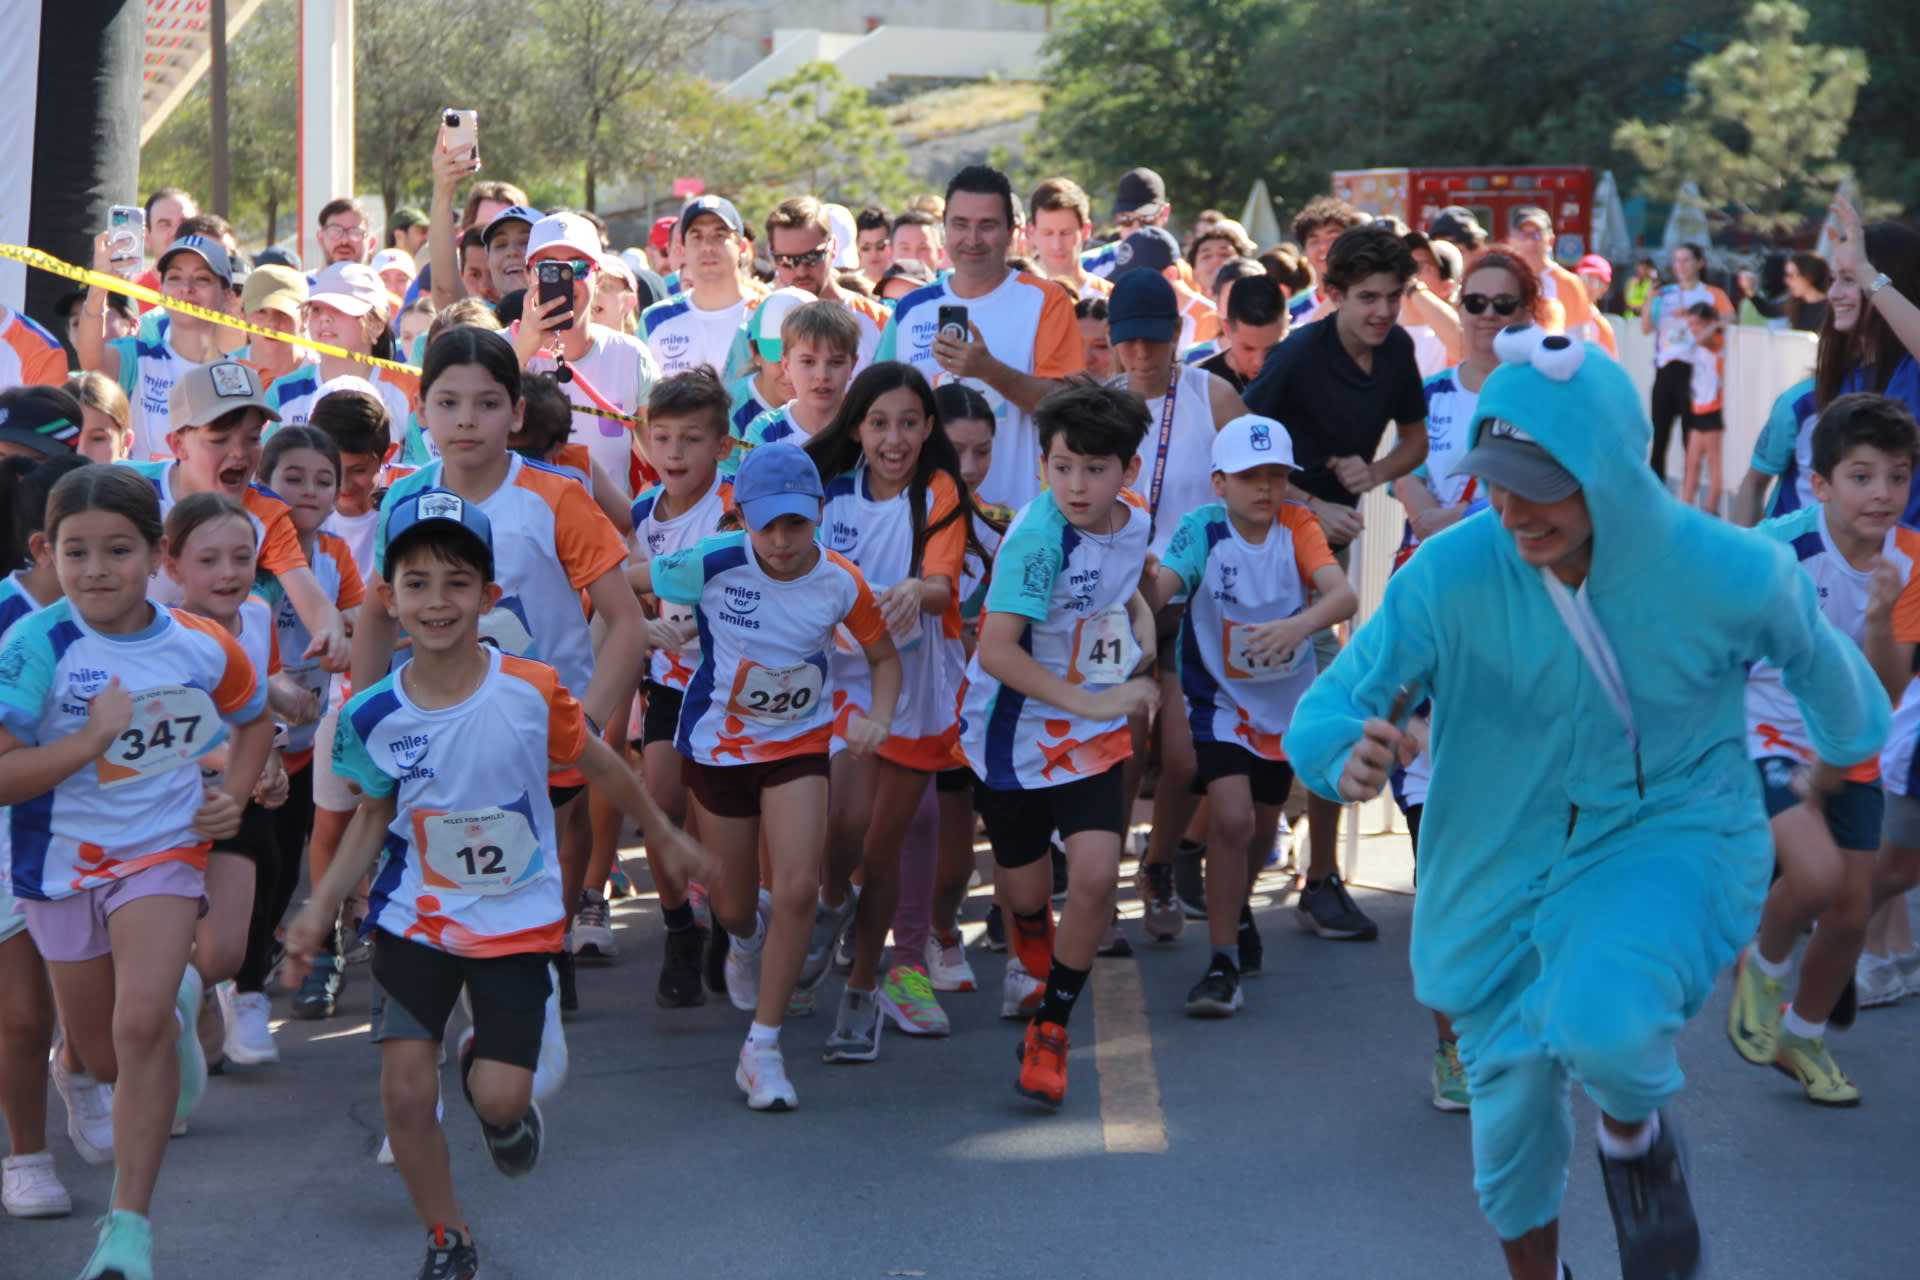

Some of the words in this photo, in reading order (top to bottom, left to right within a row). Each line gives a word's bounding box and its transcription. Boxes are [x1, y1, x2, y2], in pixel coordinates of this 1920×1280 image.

[659, 335, 690, 345] miles
[725, 585, 761, 600] miles
[734, 597, 749, 606] for
[719, 611, 761, 629] smiles
[1088, 638, 1122, 665] 41
[747, 687, 811, 714] 220
[119, 715, 202, 761] 347
[388, 734, 429, 752] miles
[400, 766, 434, 784] miles
[443, 817, 463, 825] MILES
[481, 812, 504, 822] SMILES
[456, 845, 507, 876] 12
